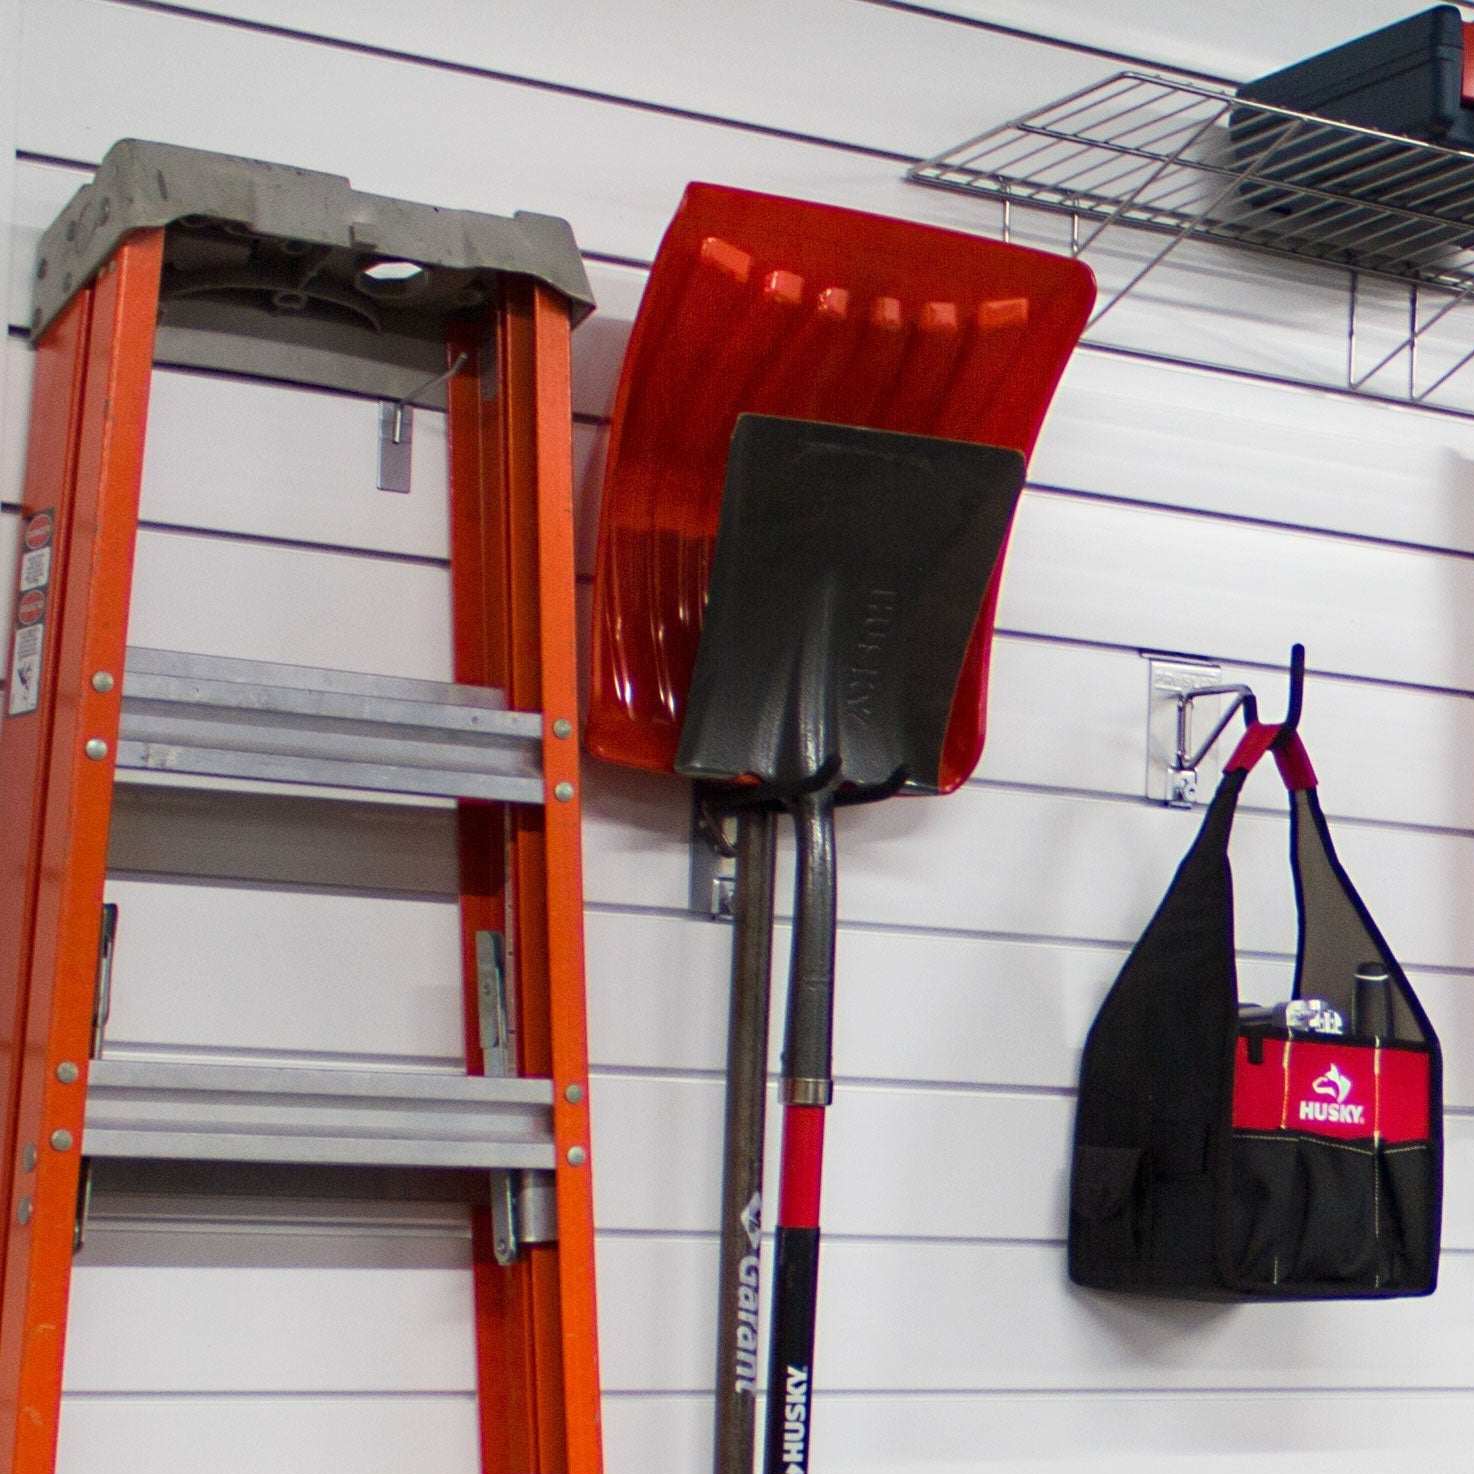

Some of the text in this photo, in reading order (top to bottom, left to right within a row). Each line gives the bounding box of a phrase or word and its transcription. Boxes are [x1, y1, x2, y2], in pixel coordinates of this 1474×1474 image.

[1299, 1101, 1364, 1124] HUSKY
[735, 1255, 760, 1395] Garant
[783, 1365, 808, 1463] HUSKY
